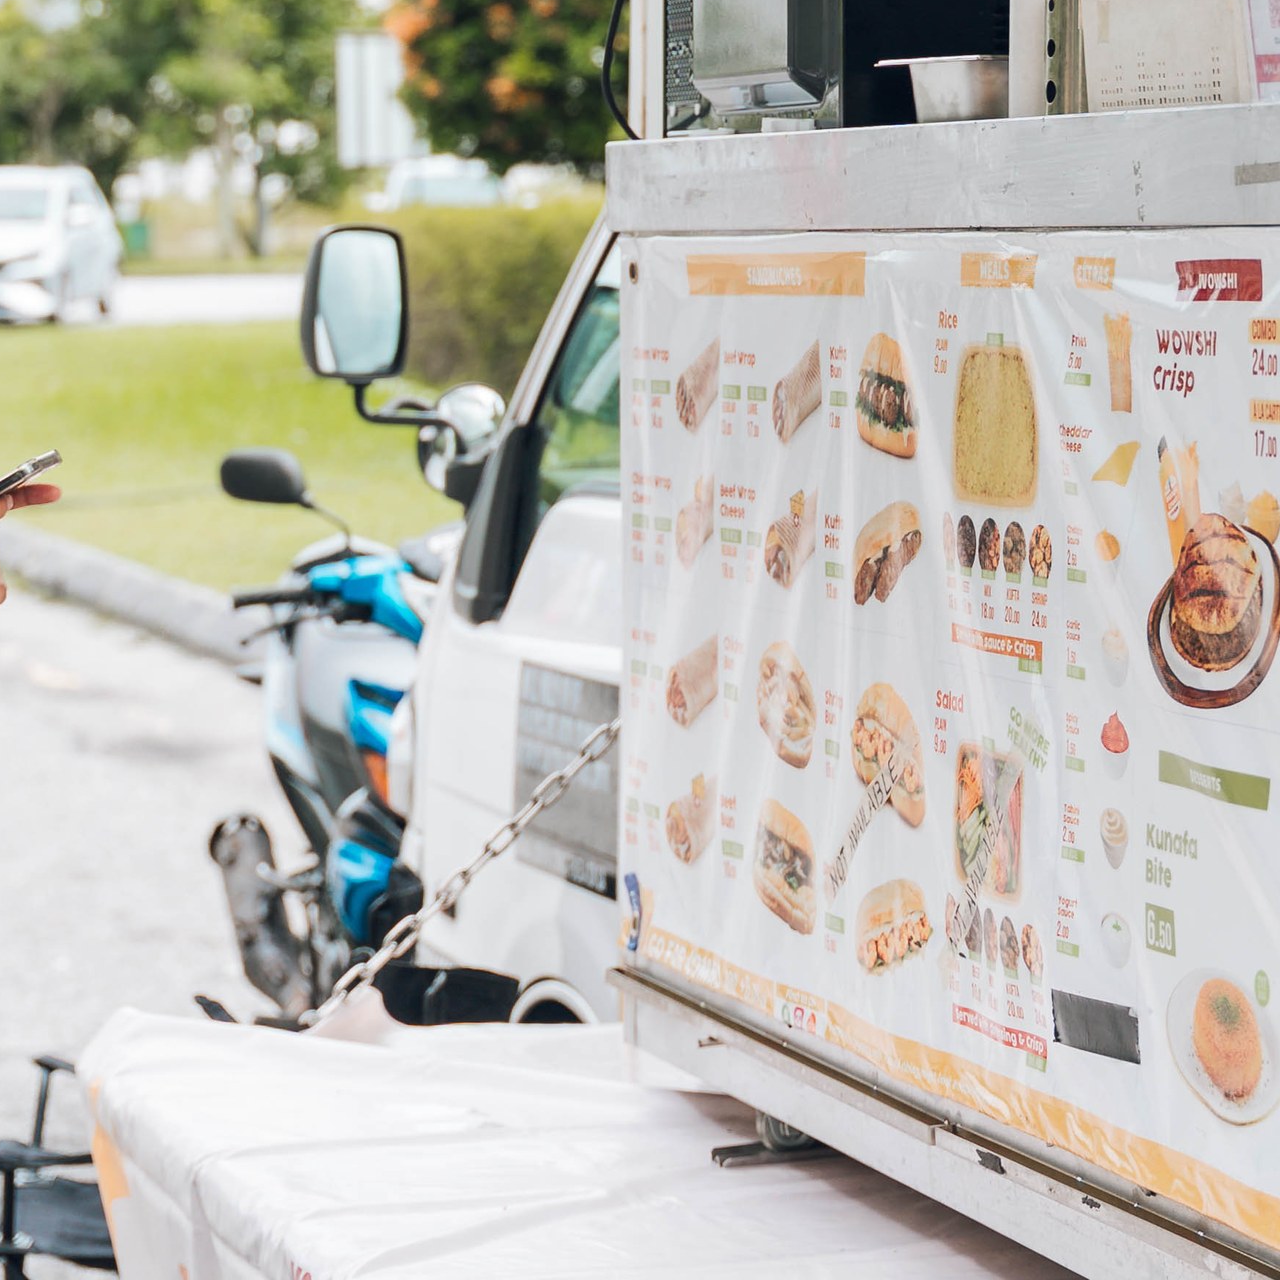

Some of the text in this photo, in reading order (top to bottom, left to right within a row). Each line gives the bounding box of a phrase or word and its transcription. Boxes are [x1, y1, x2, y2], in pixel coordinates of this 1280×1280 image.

[746, 267, 802, 286] SANDWICHES
[980, 261, 1010, 280] MEALS
[938, 309, 958, 329] Rice
[1252, 320, 1277, 340] COMBO
[1156, 329, 1217, 356] WOWSHI
[1252, 348, 1278, 376] 24.00
[1254, 430, 1277, 457] 17.00
[1007, 640, 1013, 651] &
[936, 688, 964, 713] Salad
[1010, 706, 1022, 727] GO
[1146, 823, 1198, 860] Kunafa
[829, 846, 849, 897] NOT
[1145, 858, 1172, 888] Bite
[1147, 909, 1172, 951] 6.50
